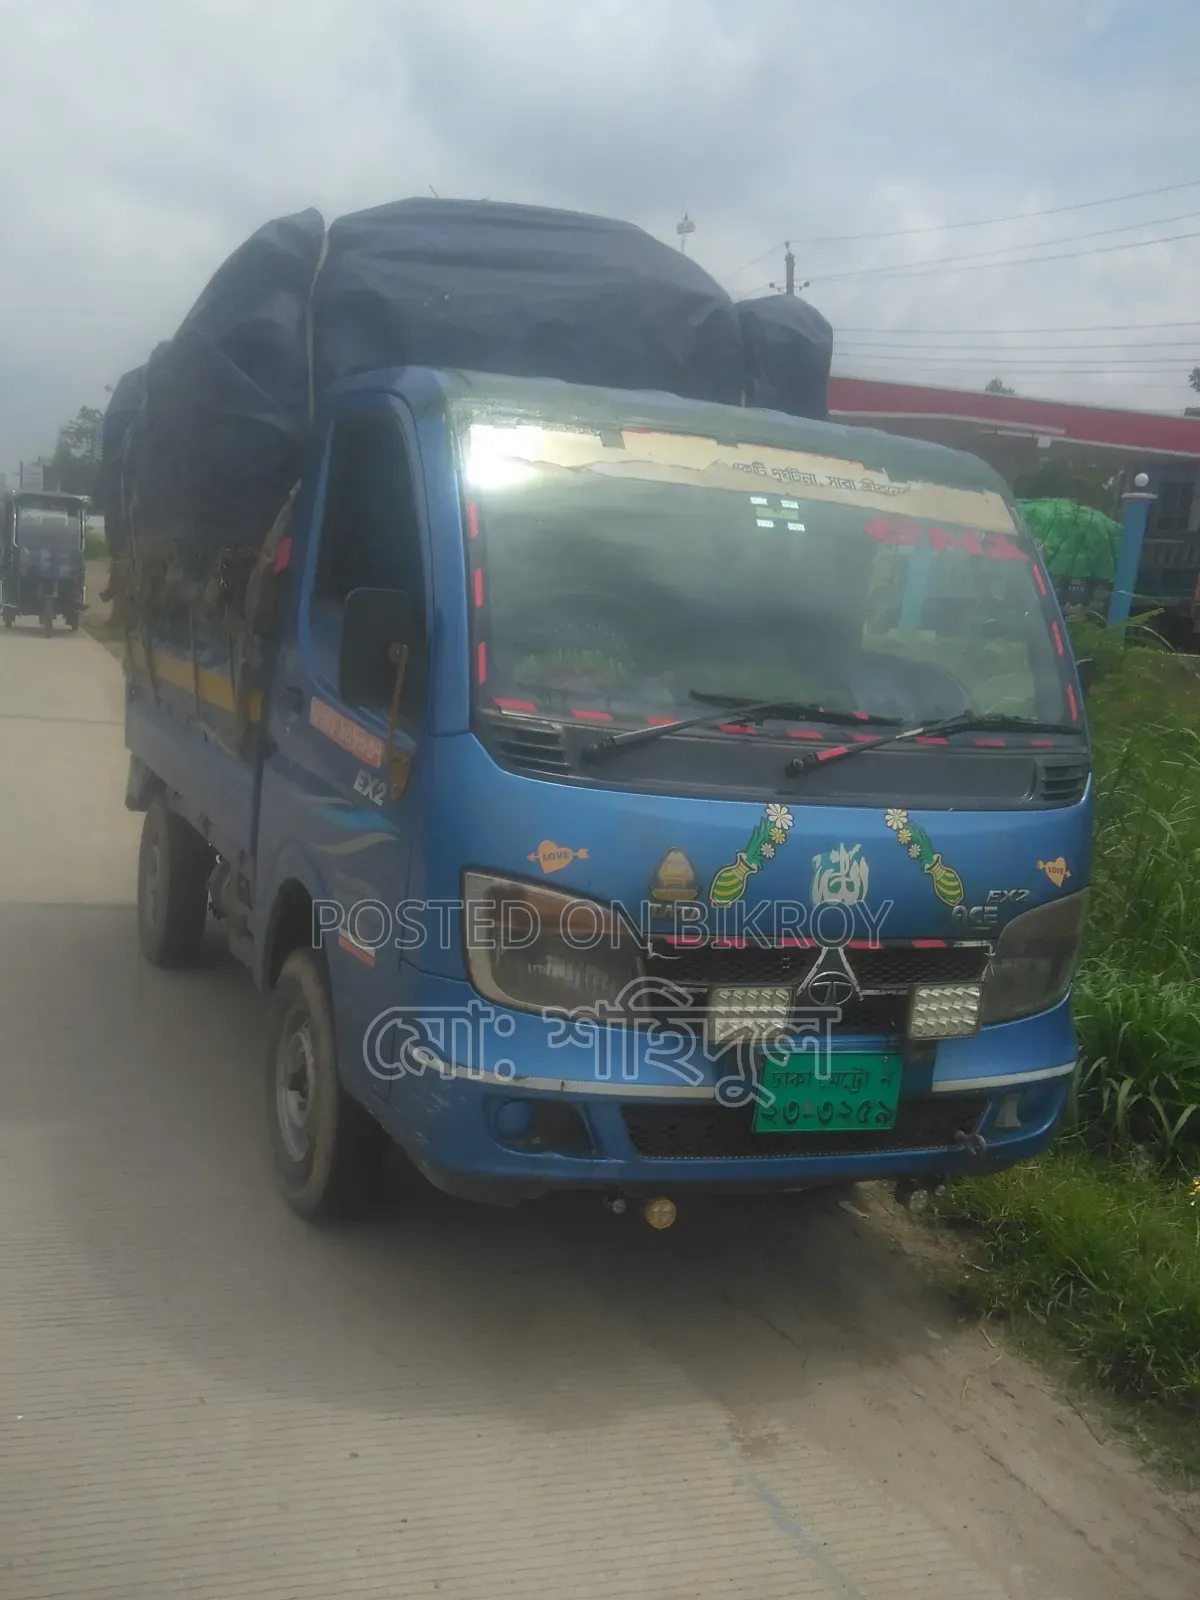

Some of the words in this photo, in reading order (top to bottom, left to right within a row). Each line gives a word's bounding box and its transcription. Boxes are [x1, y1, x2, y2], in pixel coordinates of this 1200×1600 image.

[353, 767, 388, 807] EX2
[542, 851, 570, 862] LOVE
[1047, 865, 1065, 876] LOVE
[986, 888, 1030, 904] EX2
[951, 905, 998, 926] ACE
[772, 1067, 813, 1088] ঢাকা
[817, 1066, 870, 1093] মেট্রো
